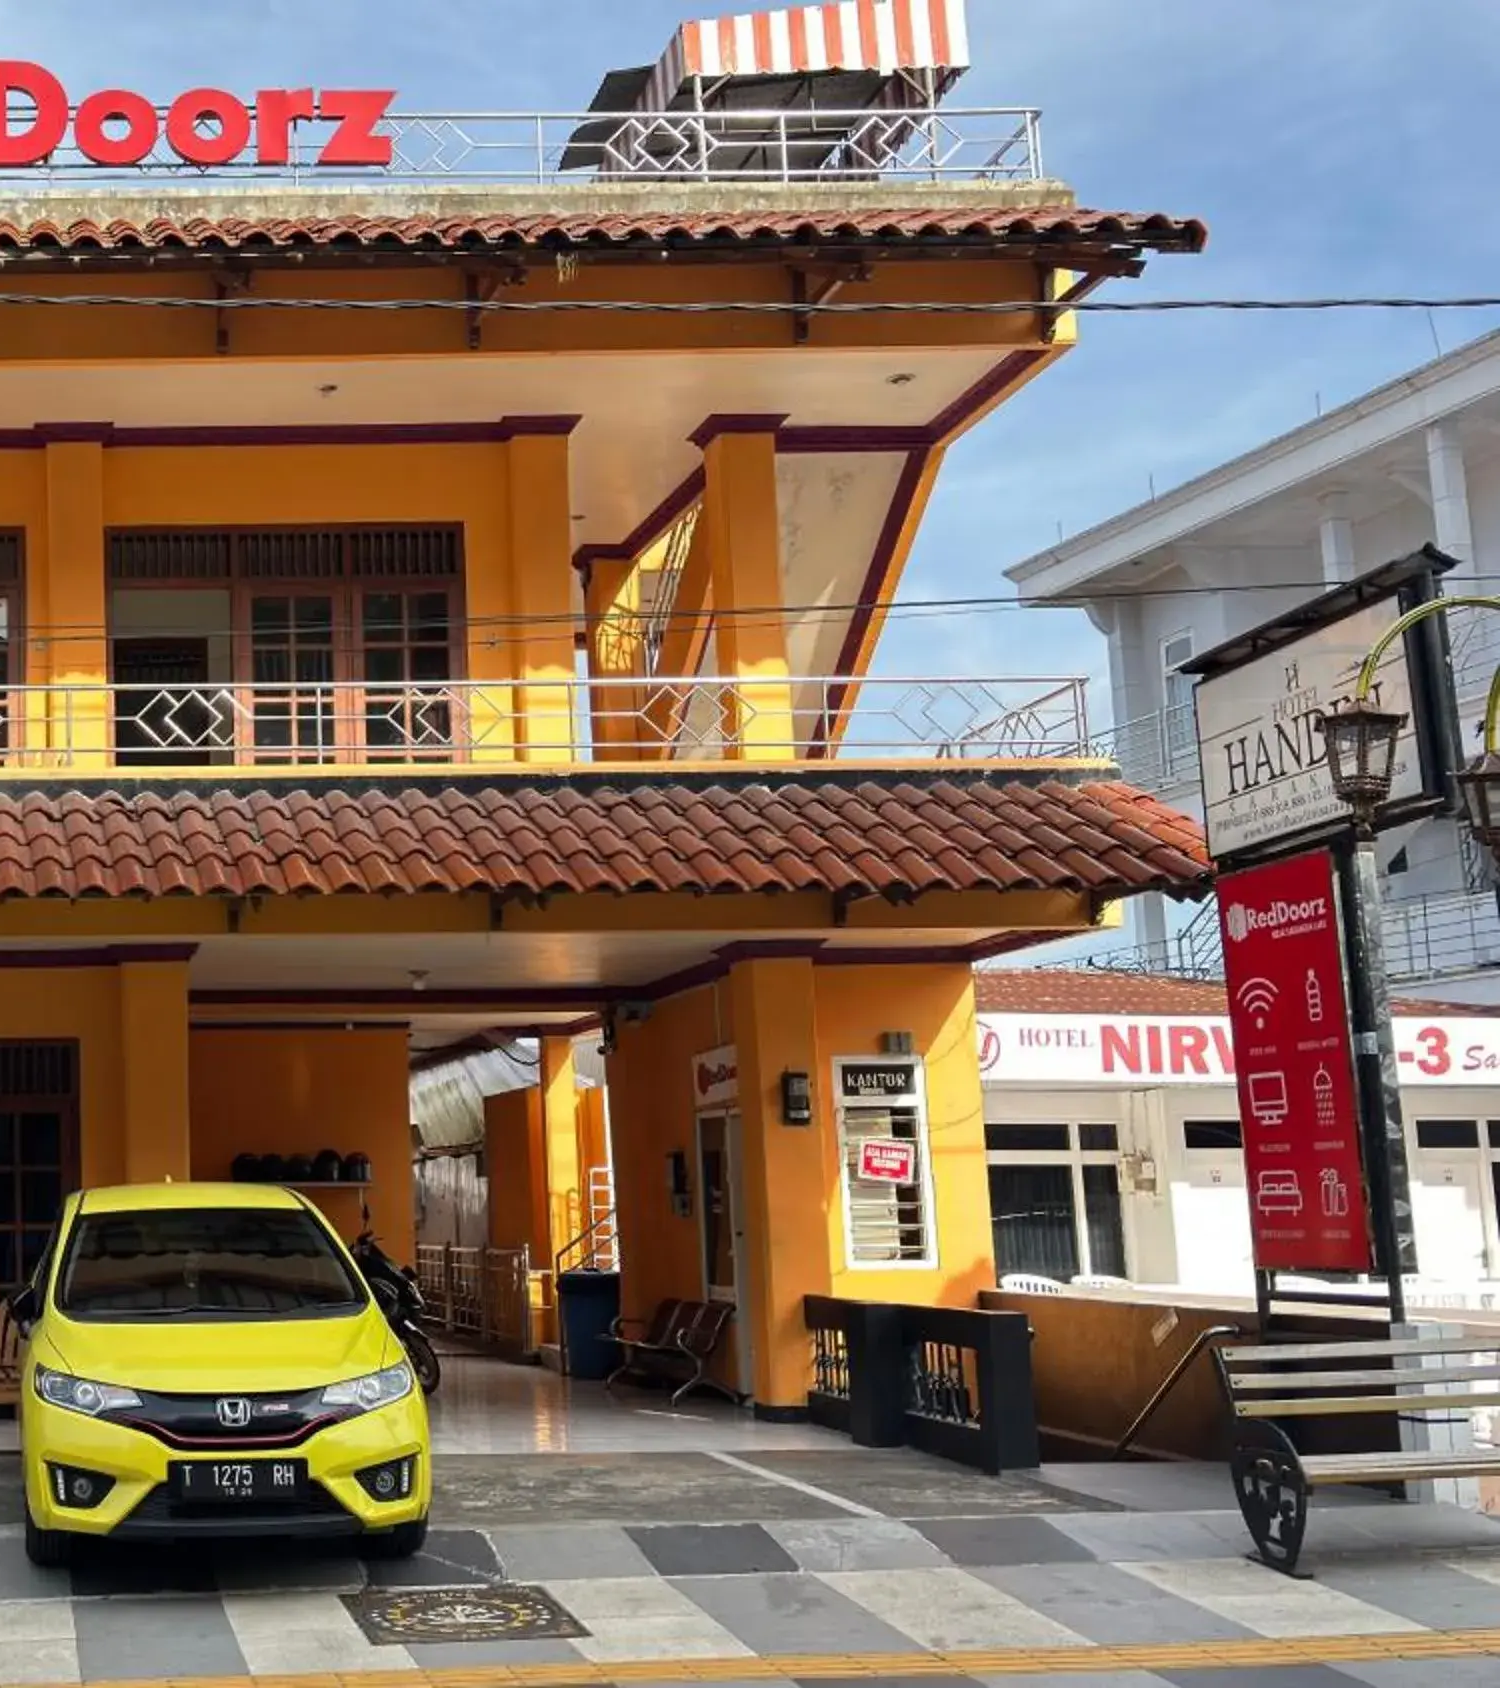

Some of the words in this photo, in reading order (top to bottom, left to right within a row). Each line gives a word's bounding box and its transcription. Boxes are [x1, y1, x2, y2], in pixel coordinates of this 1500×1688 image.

[1272, 685, 1322, 723] HOTEL
[1245, 897, 1327, 931] RedDoorz
[1018, 1027, 1095, 1048] HOTEL
[846, 1072, 906, 1088] KANTOR
[182, 1465, 193, 1487] T
[212, 1465, 253, 1486] 1275
[273, 1464, 295, 1486] RH
